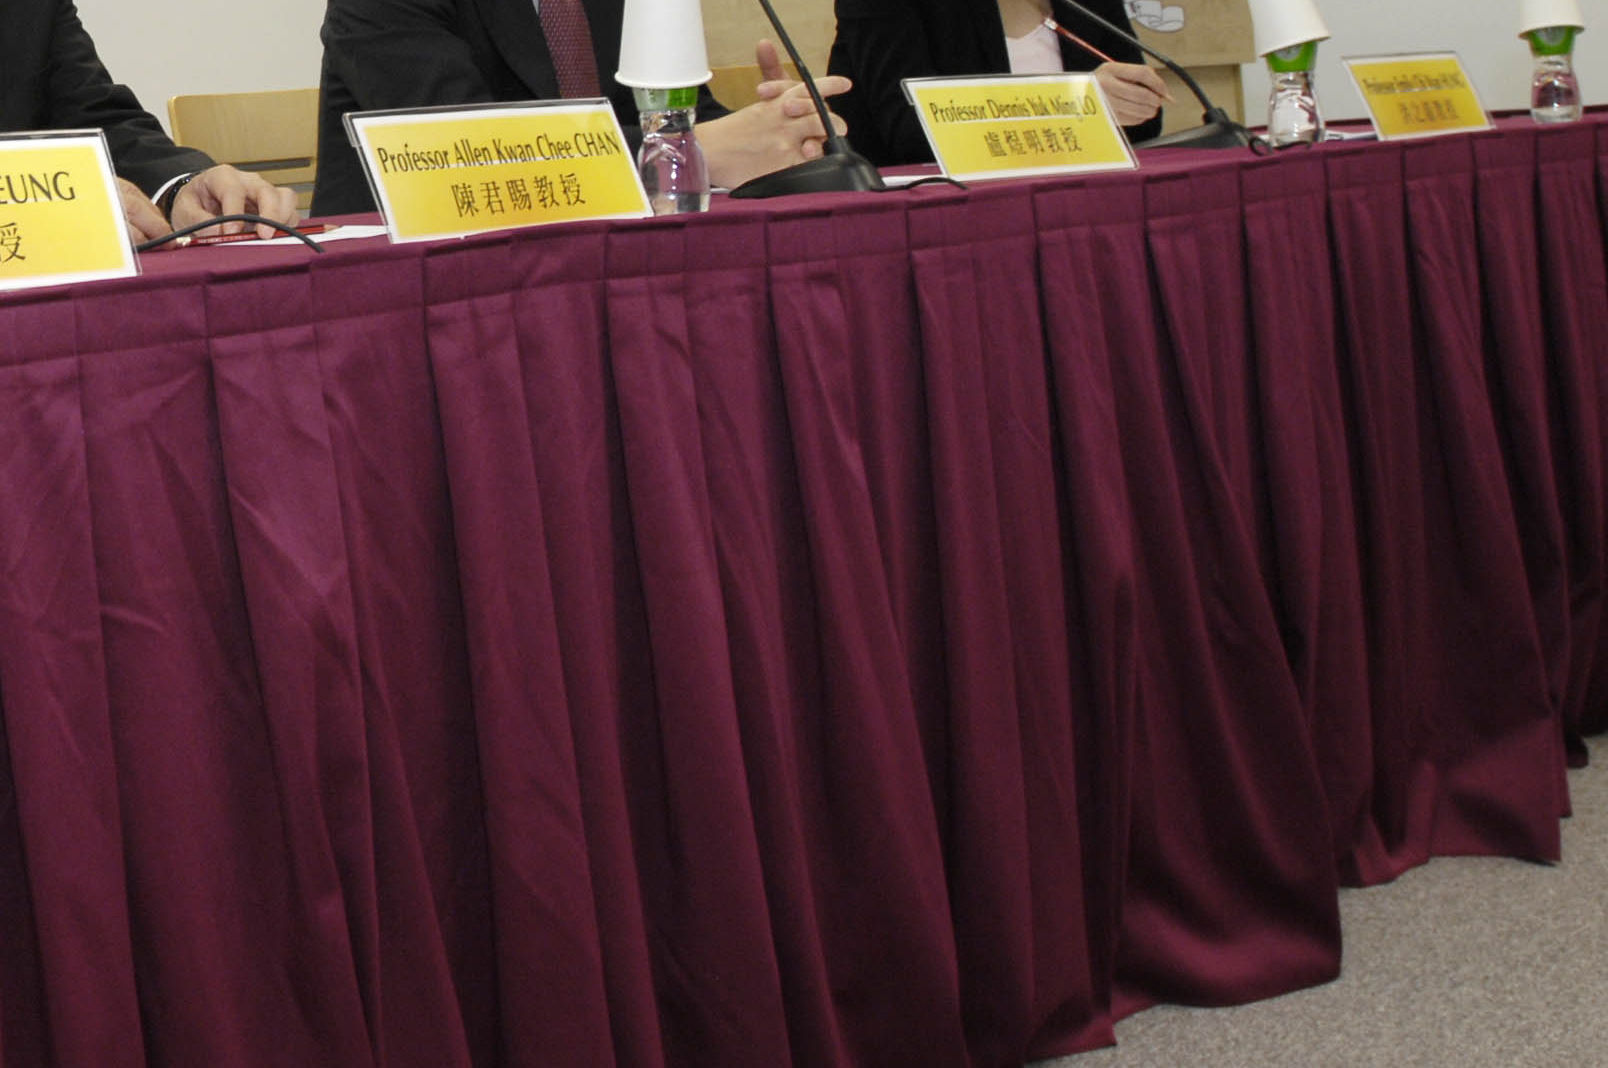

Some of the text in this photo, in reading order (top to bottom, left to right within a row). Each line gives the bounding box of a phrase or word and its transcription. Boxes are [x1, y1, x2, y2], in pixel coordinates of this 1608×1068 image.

[929, 100, 988, 123] Professor
[987, 97, 1031, 119] Dennis
[377, 131, 622, 174] Professor Allen Kwan Chee CHAN
[450, 172, 587, 218] 陳君賜教授
